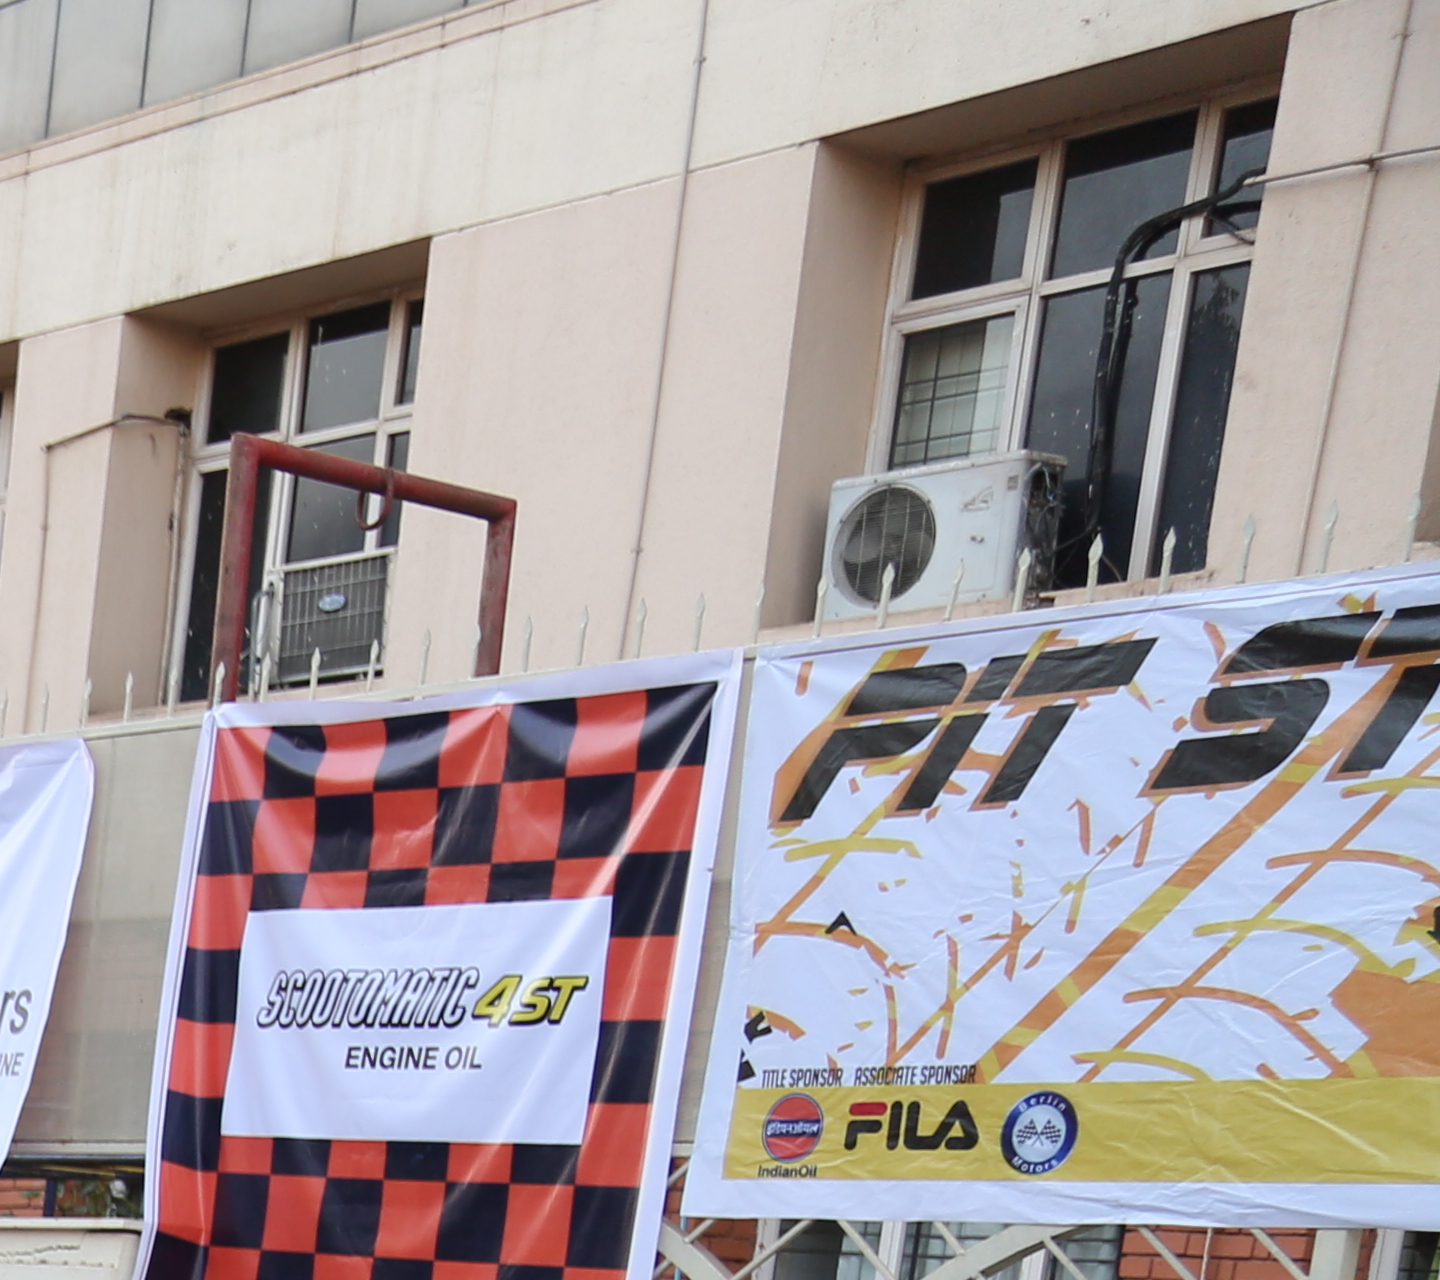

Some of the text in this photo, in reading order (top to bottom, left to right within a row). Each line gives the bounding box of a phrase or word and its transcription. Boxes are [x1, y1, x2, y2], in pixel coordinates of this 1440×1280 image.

[776, 637, 1159, 823] PIT
[257, 966, 590, 1030] SCOOTOMATIC 4ST
[345, 1046, 483, 1070] ENGINE OIL
[761, 1064, 977, 1089] TITLE SPONSOR ASSOCIATE SPONSOR
[1017, 1093, 1068, 1113] Berlin
[844, 1099, 979, 1151] FILA
[757, 1164, 818, 1179] IndianOil
[1010, 1155, 1059, 1174] Motors
